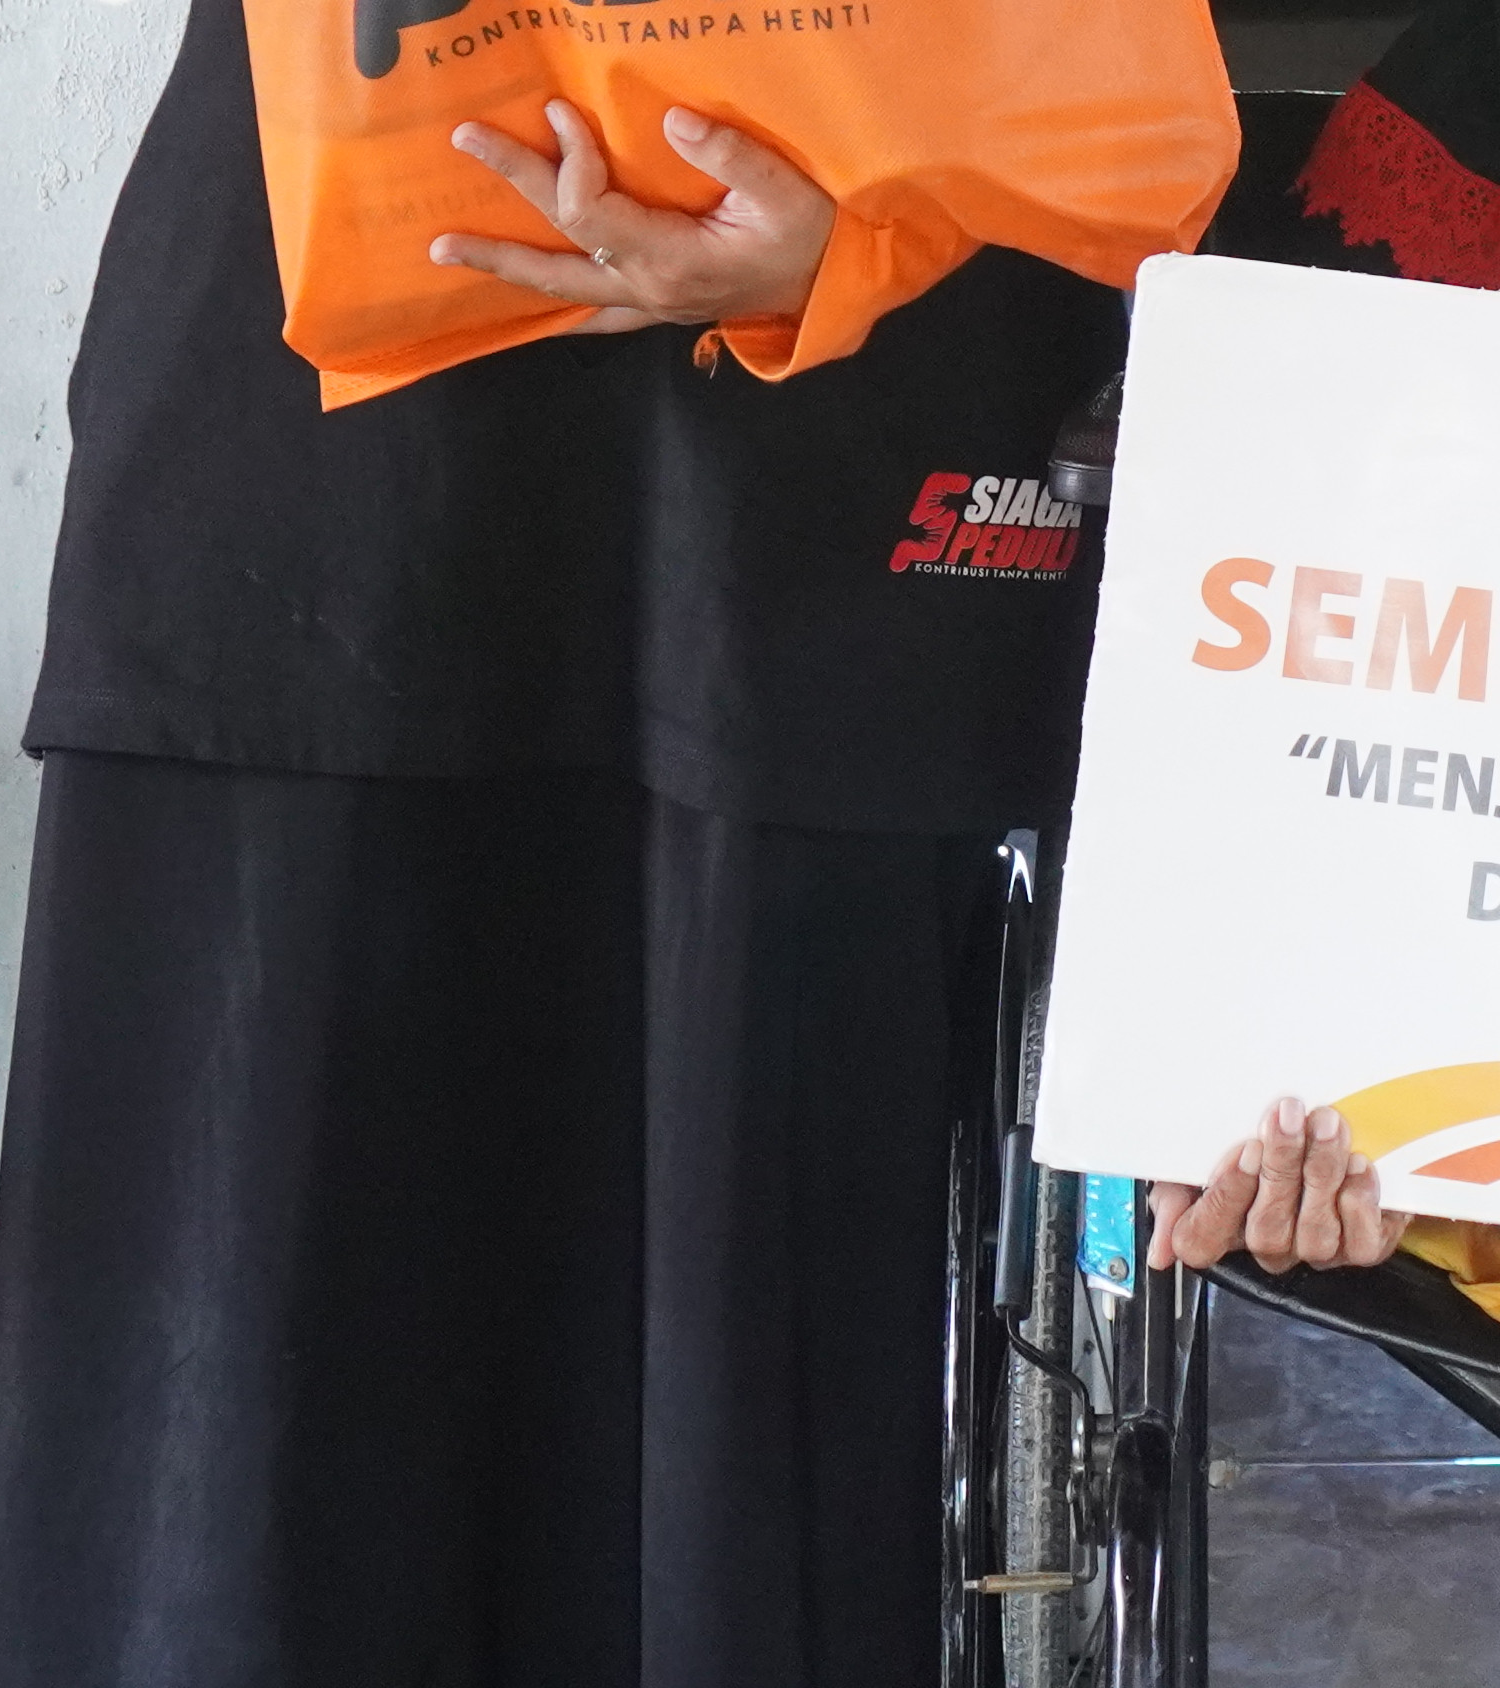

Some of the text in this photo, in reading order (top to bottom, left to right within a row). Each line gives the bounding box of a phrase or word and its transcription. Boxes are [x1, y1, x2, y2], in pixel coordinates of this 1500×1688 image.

[425, 4, 870, 67] KONTRIBSI TANPA HENTI
[944, 523, 1081, 571] PEDULI
[915, 563, 990, 578] KONTRIBUSI
[993, 570, 1030, 580] TANPA
